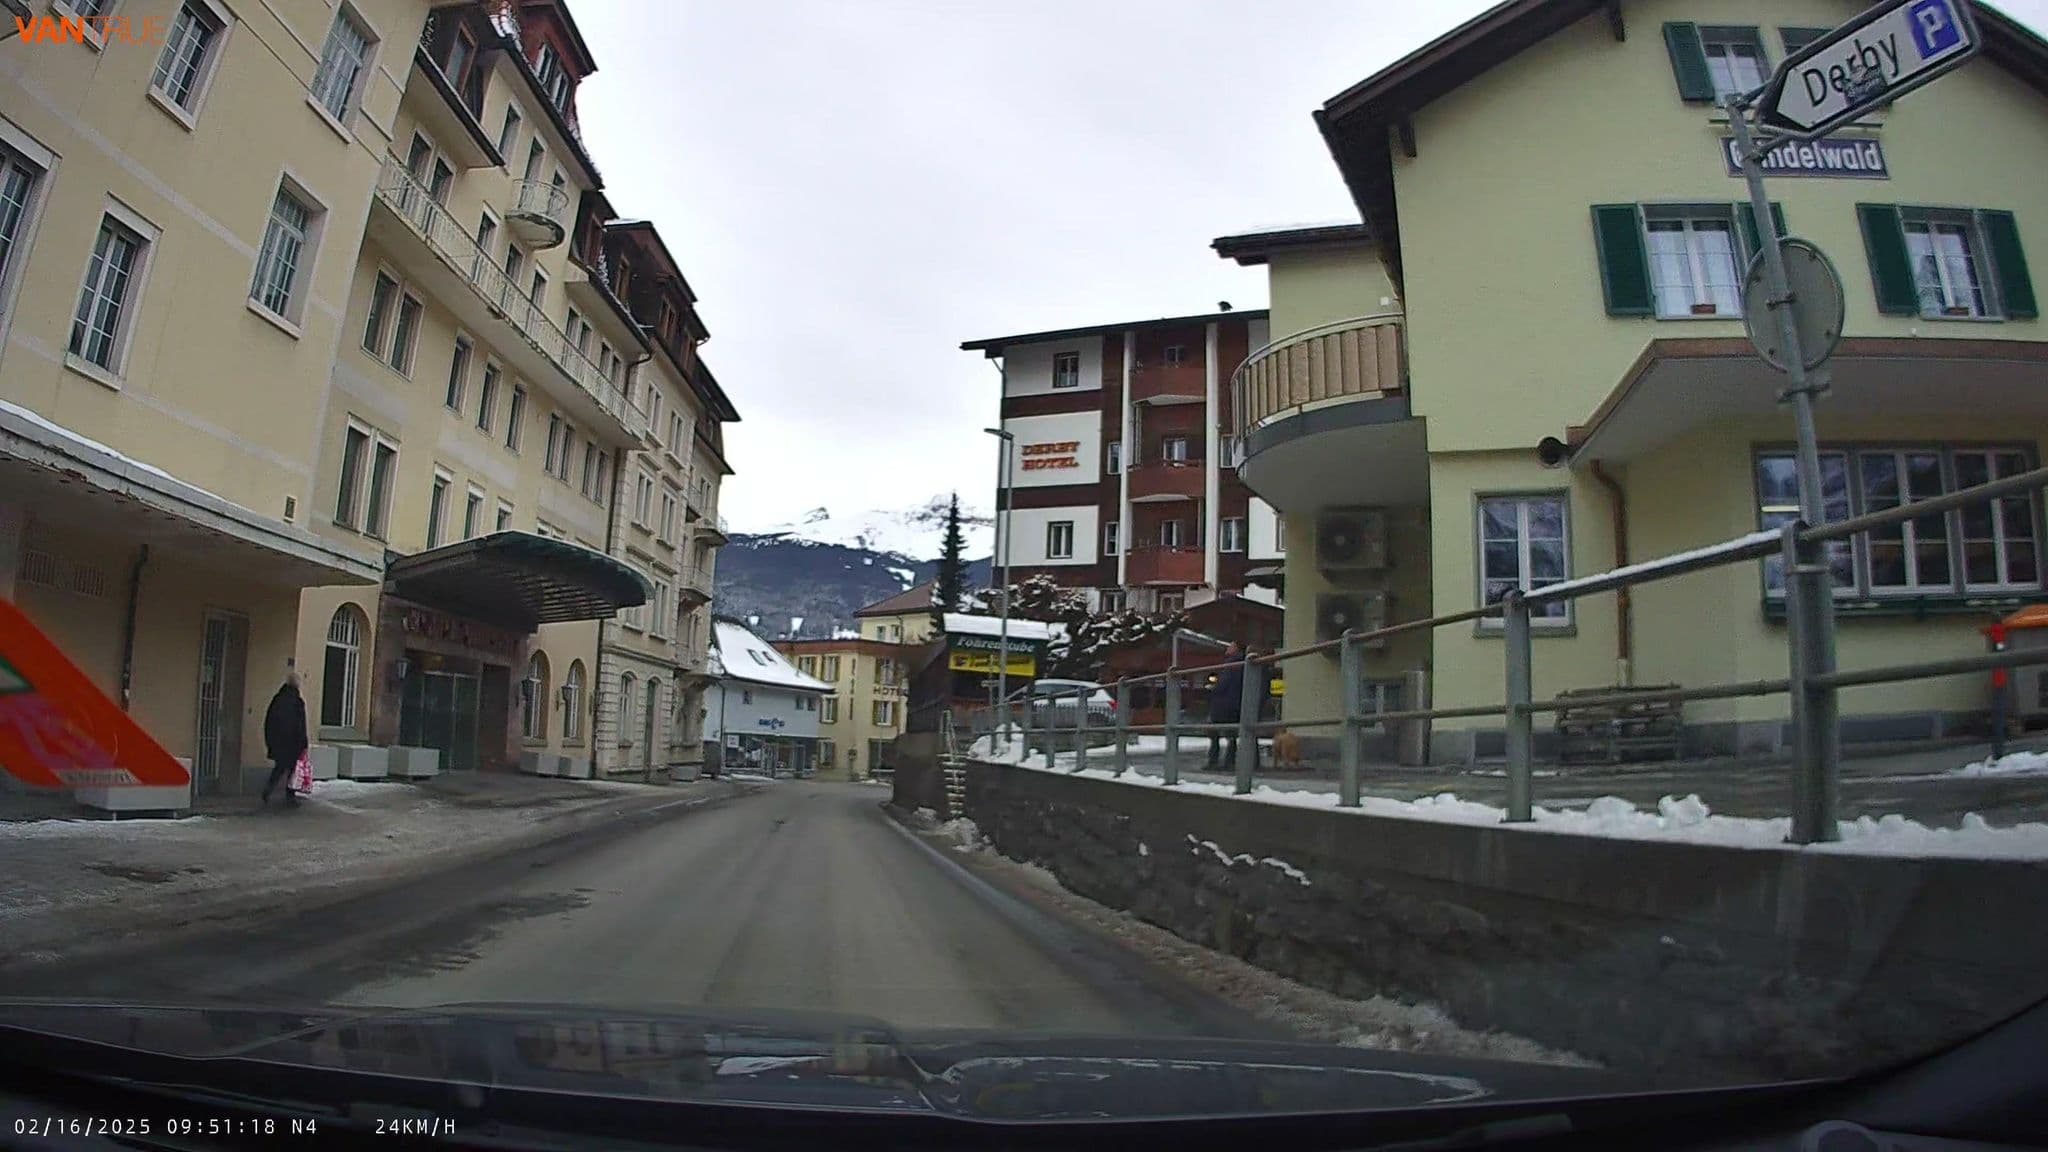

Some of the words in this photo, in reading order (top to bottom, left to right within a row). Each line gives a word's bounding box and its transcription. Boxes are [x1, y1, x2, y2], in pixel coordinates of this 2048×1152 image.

[1802, 33, 1899, 107] Derby
[1916, 6, 1945, 49] P
[1022, 457, 1080, 470] HOTEL
